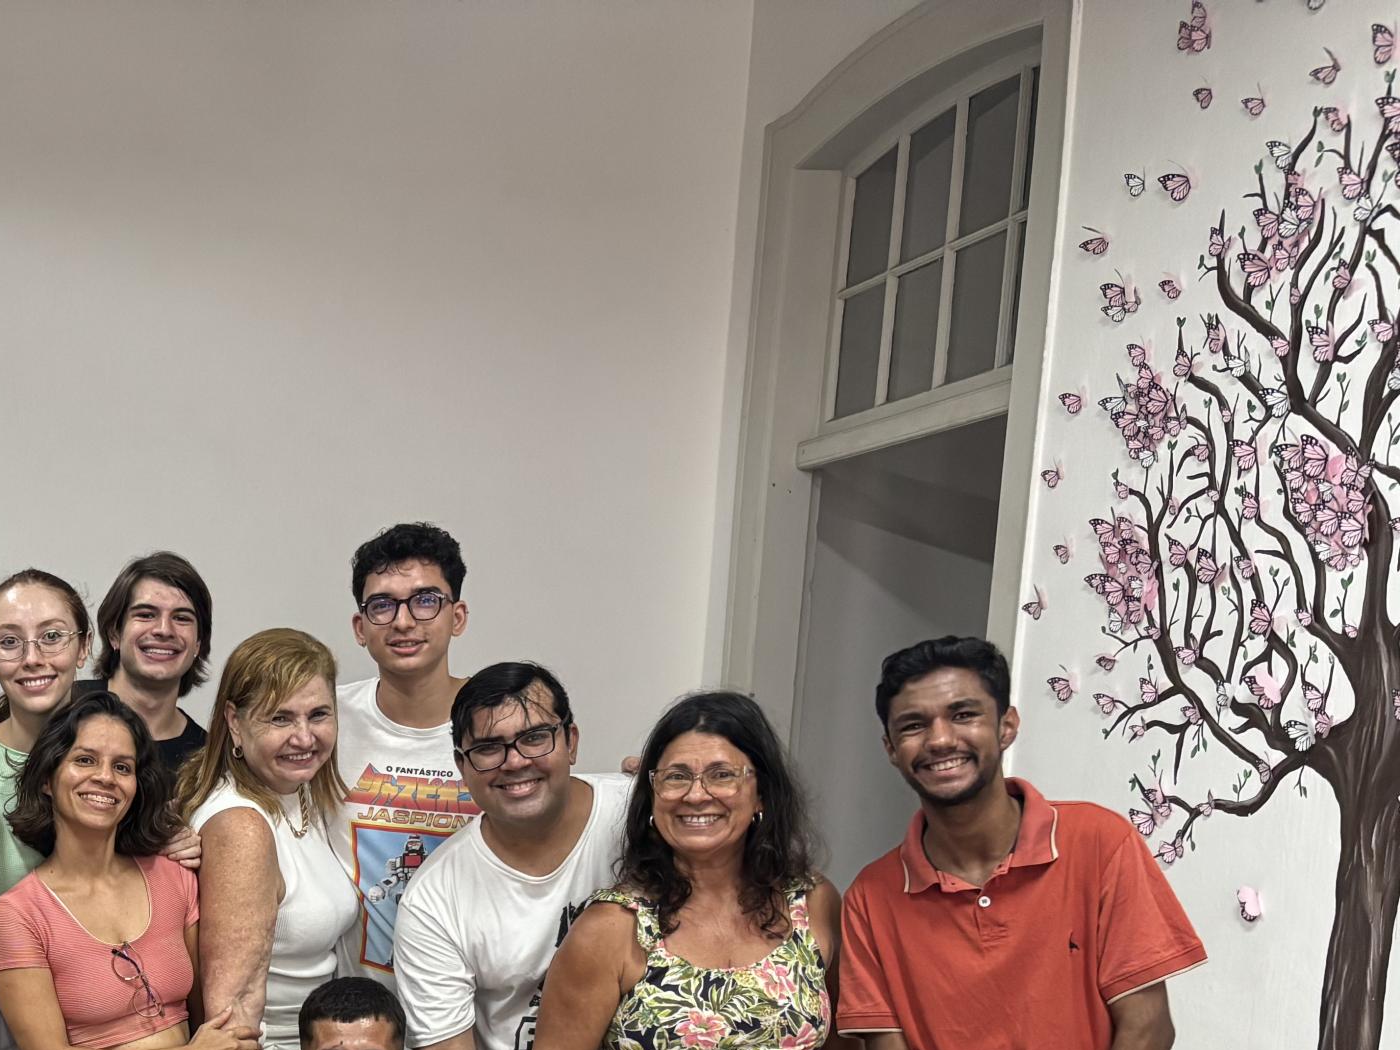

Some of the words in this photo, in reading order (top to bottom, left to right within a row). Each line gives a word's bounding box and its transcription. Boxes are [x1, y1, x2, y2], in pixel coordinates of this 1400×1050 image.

[386, 765, 393, 773] O
[395, 766, 454, 778] FANTÁSTICO
[357, 807, 474, 829] JASPION
